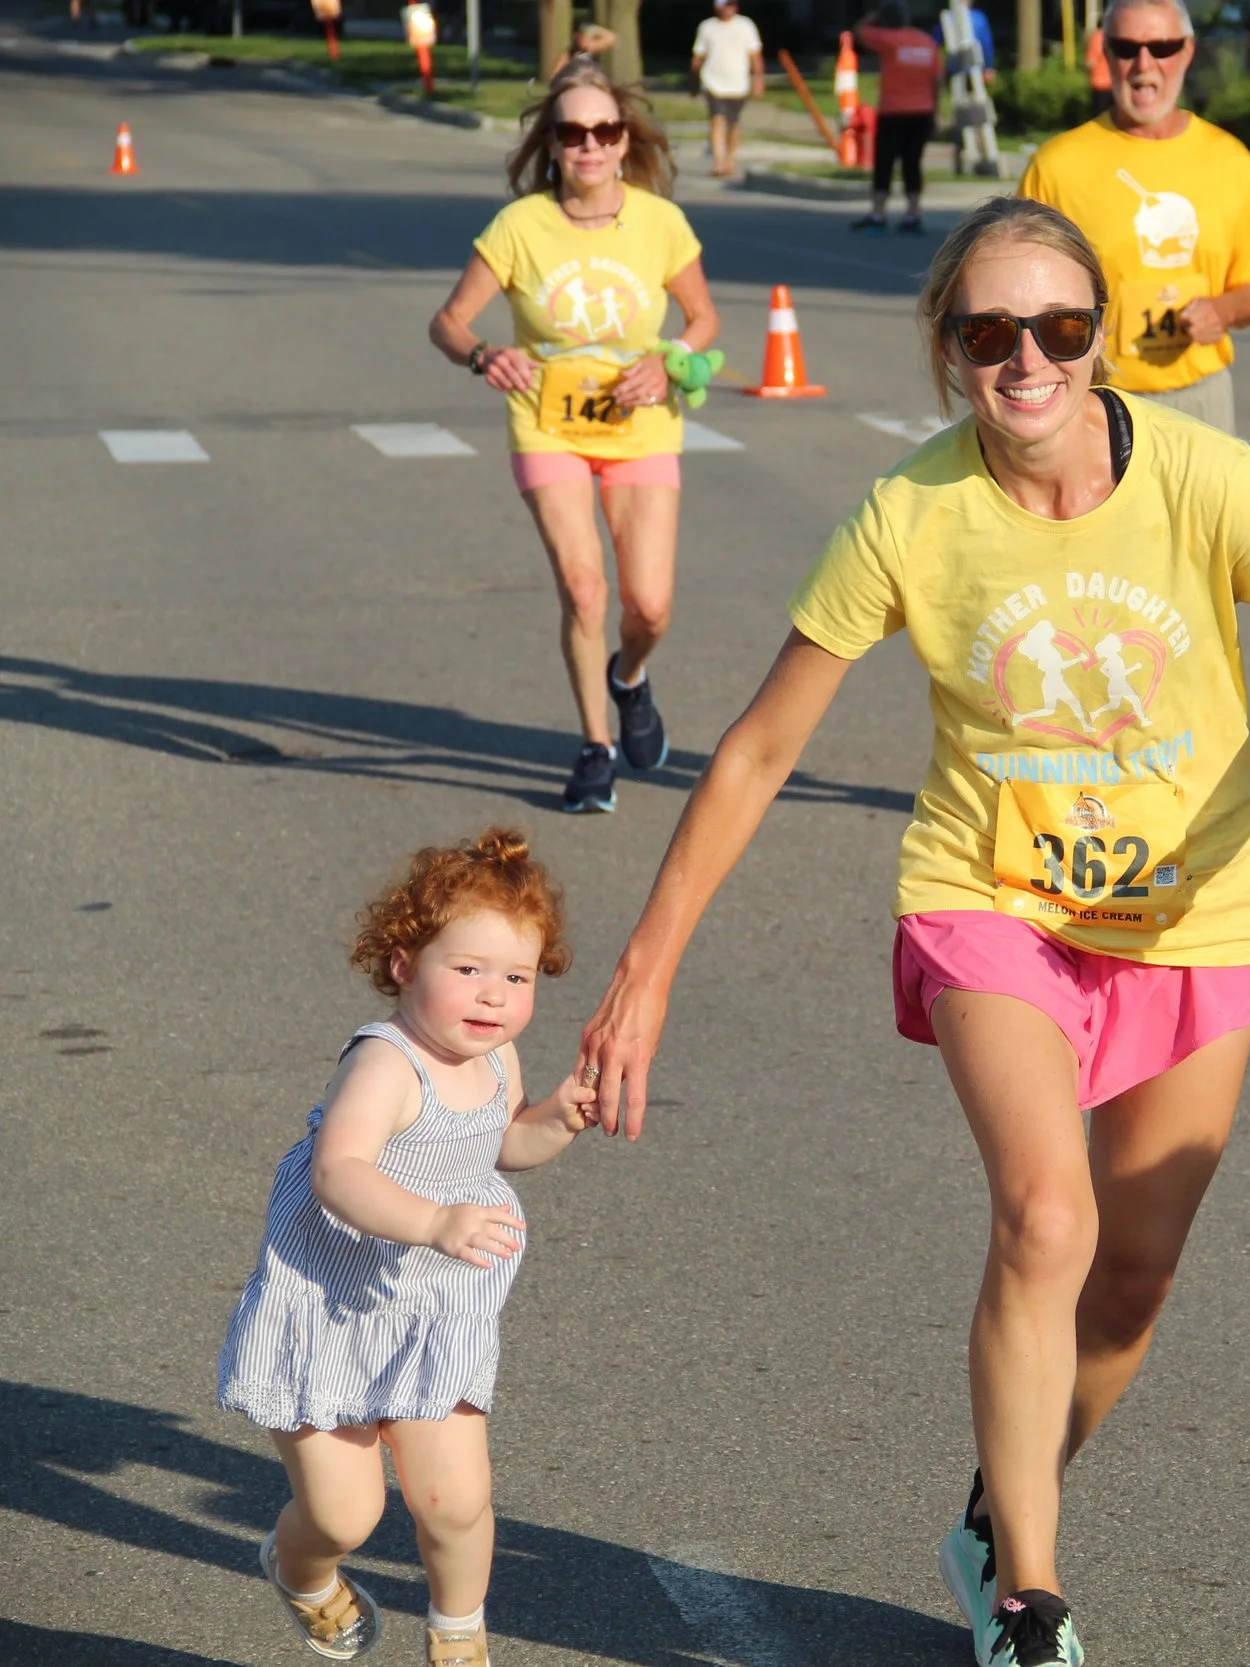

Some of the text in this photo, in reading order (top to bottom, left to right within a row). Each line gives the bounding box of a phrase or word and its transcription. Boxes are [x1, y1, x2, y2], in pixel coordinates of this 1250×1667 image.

[561, 394, 618, 423] 147
[966, 571, 1191, 684] MOTHER DAUGHTER
[1030, 833, 1150, 899] 362
[1038, 901, 1143, 922] MELON ICE CREAM
